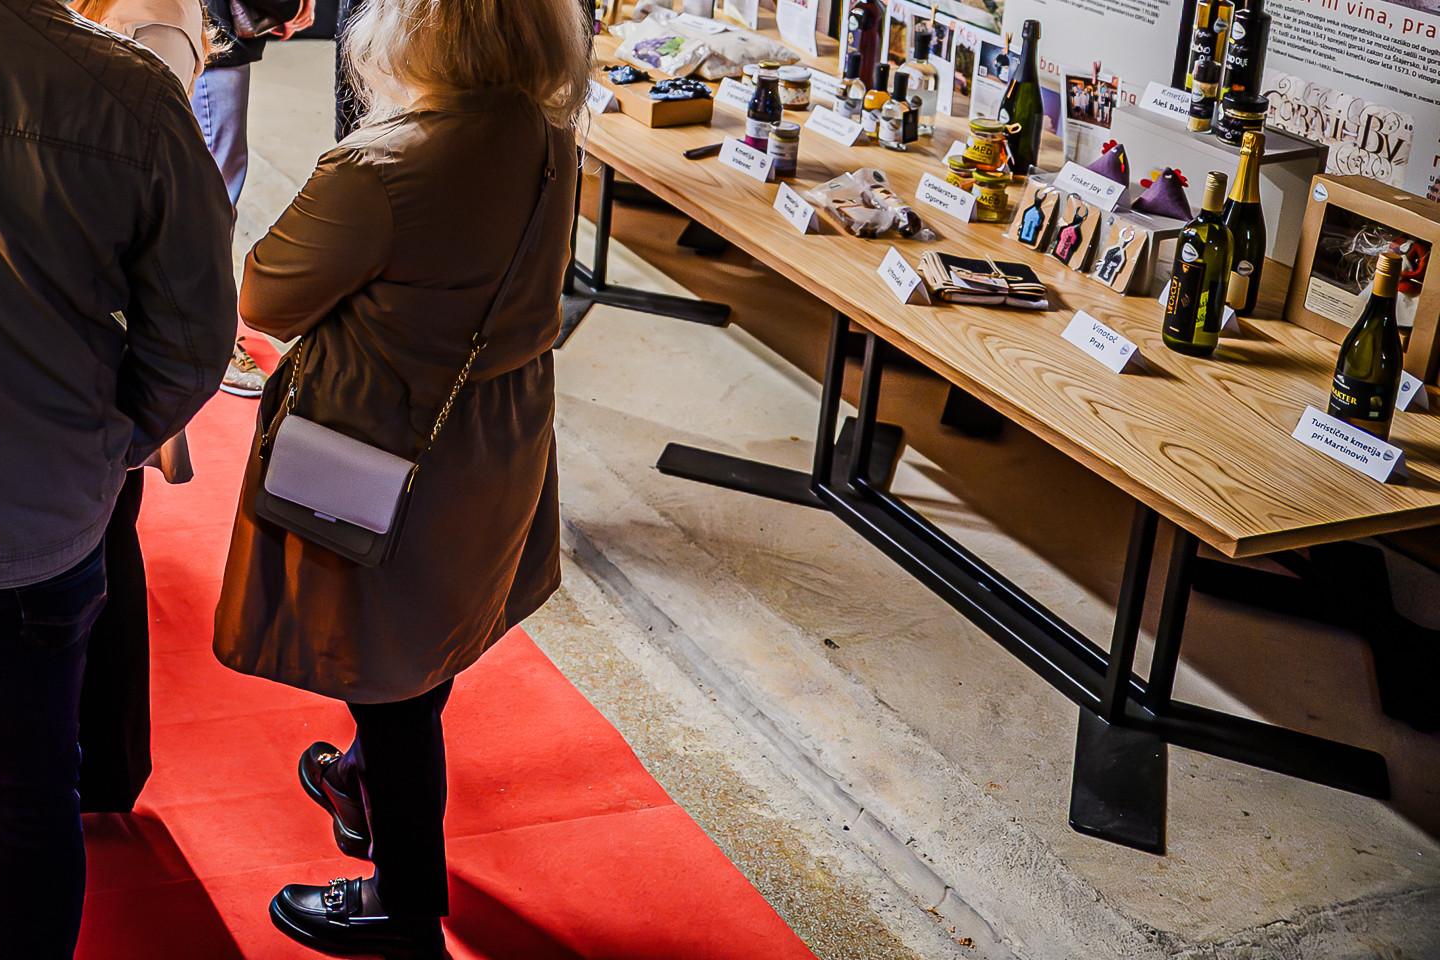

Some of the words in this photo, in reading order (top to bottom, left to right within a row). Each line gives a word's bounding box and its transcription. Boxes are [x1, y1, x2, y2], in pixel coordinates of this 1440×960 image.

[1306, 12, 1326, 22] novega
[1327, 18, 1340, 27] veka
[1341, 22, 1382, 39] vinogradništva
[1391, 37, 1411, 47] razliko
[1412, 42, 1420, 50] od
[1347, 2, 1393, 29] vina,
[1279, 30, 1289, 38] tudi
[1297, 35, 1345, 55] hrvaško-slovenski
[1346, 50, 1366, 62] kmečki
[1367, 58, 1380, 67] upor
[1381, 61, 1392, 70] leta
[1394, 65, 1410, 76] 1573.
[1298, 19, 1323, 30] podražilo
[1338, 30, 1358, 41] Kmetje
[1374, 41, 1402, 55] množično
[1418, 54, 1426, 62] na
[1301, 27, 1311, 36] leta
[1348, 42, 1365, 52] gorski
[1366, 48, 1383, 58] zakon
[1392, 54, 1421, 70] Štajersko,
[1423, 64, 1429, 72] ki
[972, 144, 993, 156] MED
[980, 193, 1000, 205] MED
[1070, 173, 1091, 189] Tinker
[1310, 430, 1323, 442] pri
[1323, 437, 1369, 465] Martinovih
[1311, 417, 1349, 442] Turistična
[1350, 436, 1382, 458] kmetija
